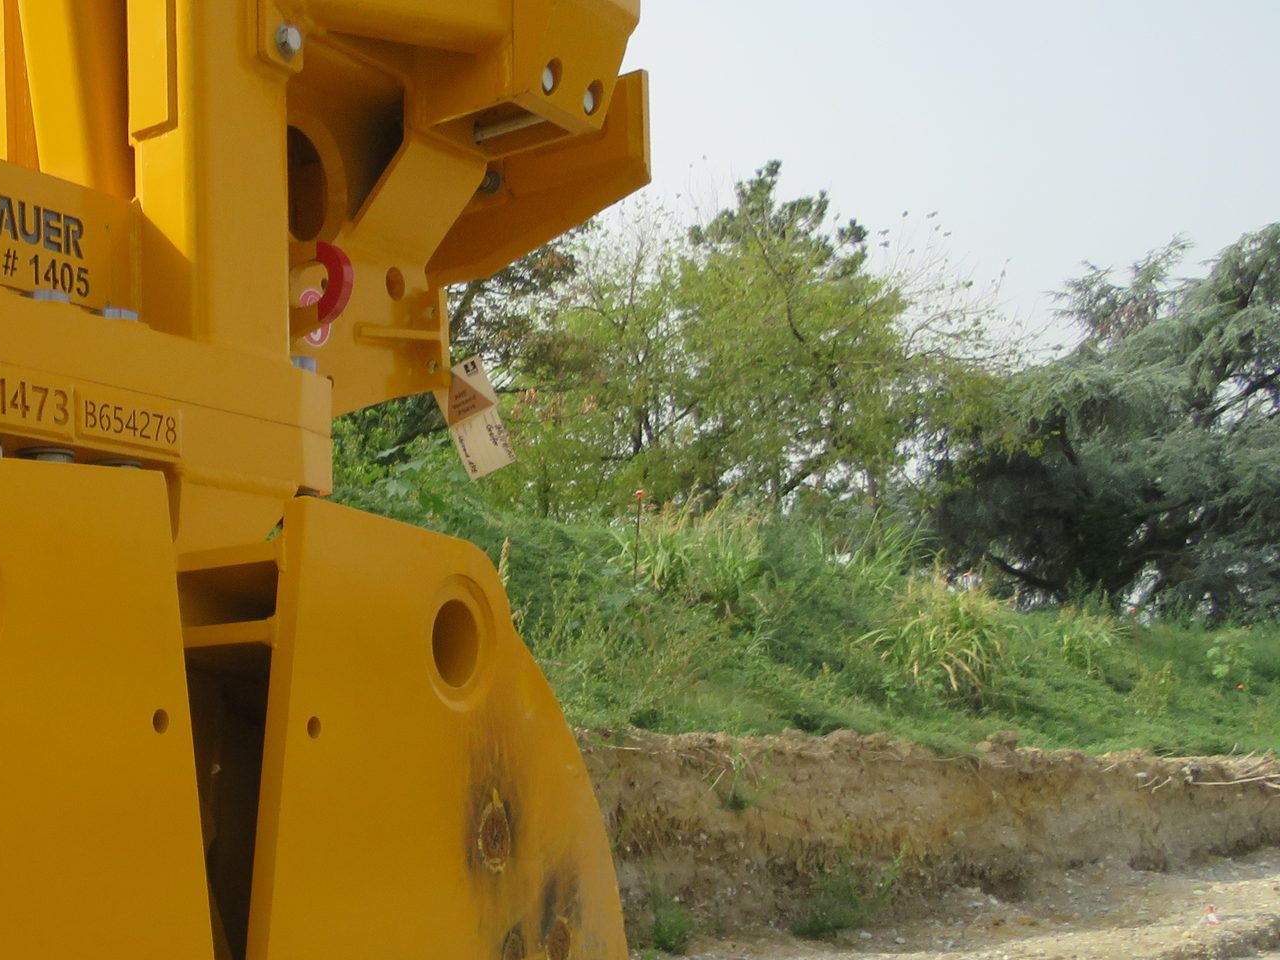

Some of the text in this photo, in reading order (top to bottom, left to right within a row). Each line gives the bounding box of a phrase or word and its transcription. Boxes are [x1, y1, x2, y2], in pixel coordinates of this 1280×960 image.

[2, 248, 19, 277] #
[29, 254, 90, 298] 1405
[84, 399, 177, 445] B654278
